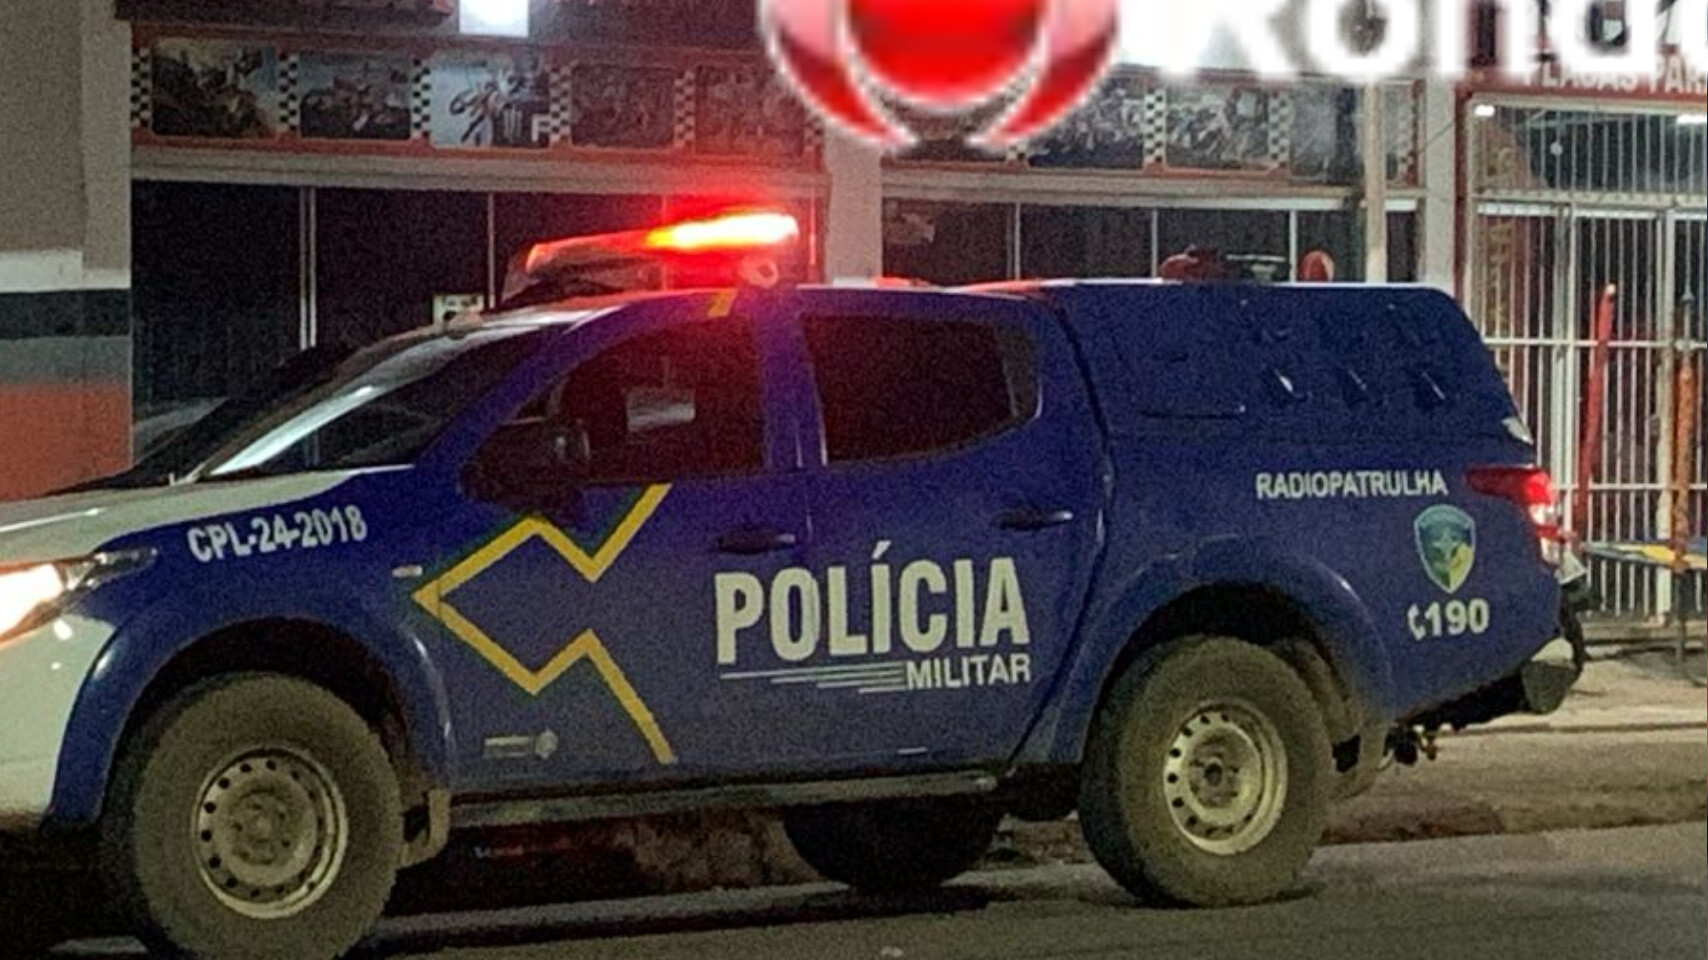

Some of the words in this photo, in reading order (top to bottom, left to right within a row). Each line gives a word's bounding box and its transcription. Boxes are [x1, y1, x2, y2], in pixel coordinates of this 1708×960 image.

[1256, 470, 1449, 499] RADIOPATRULHA
[187, 505, 368, 562] CPL-24-2018
[714, 540, 1030, 665] POLÍCIA
[905, 652, 1031, 690] MILITAR
